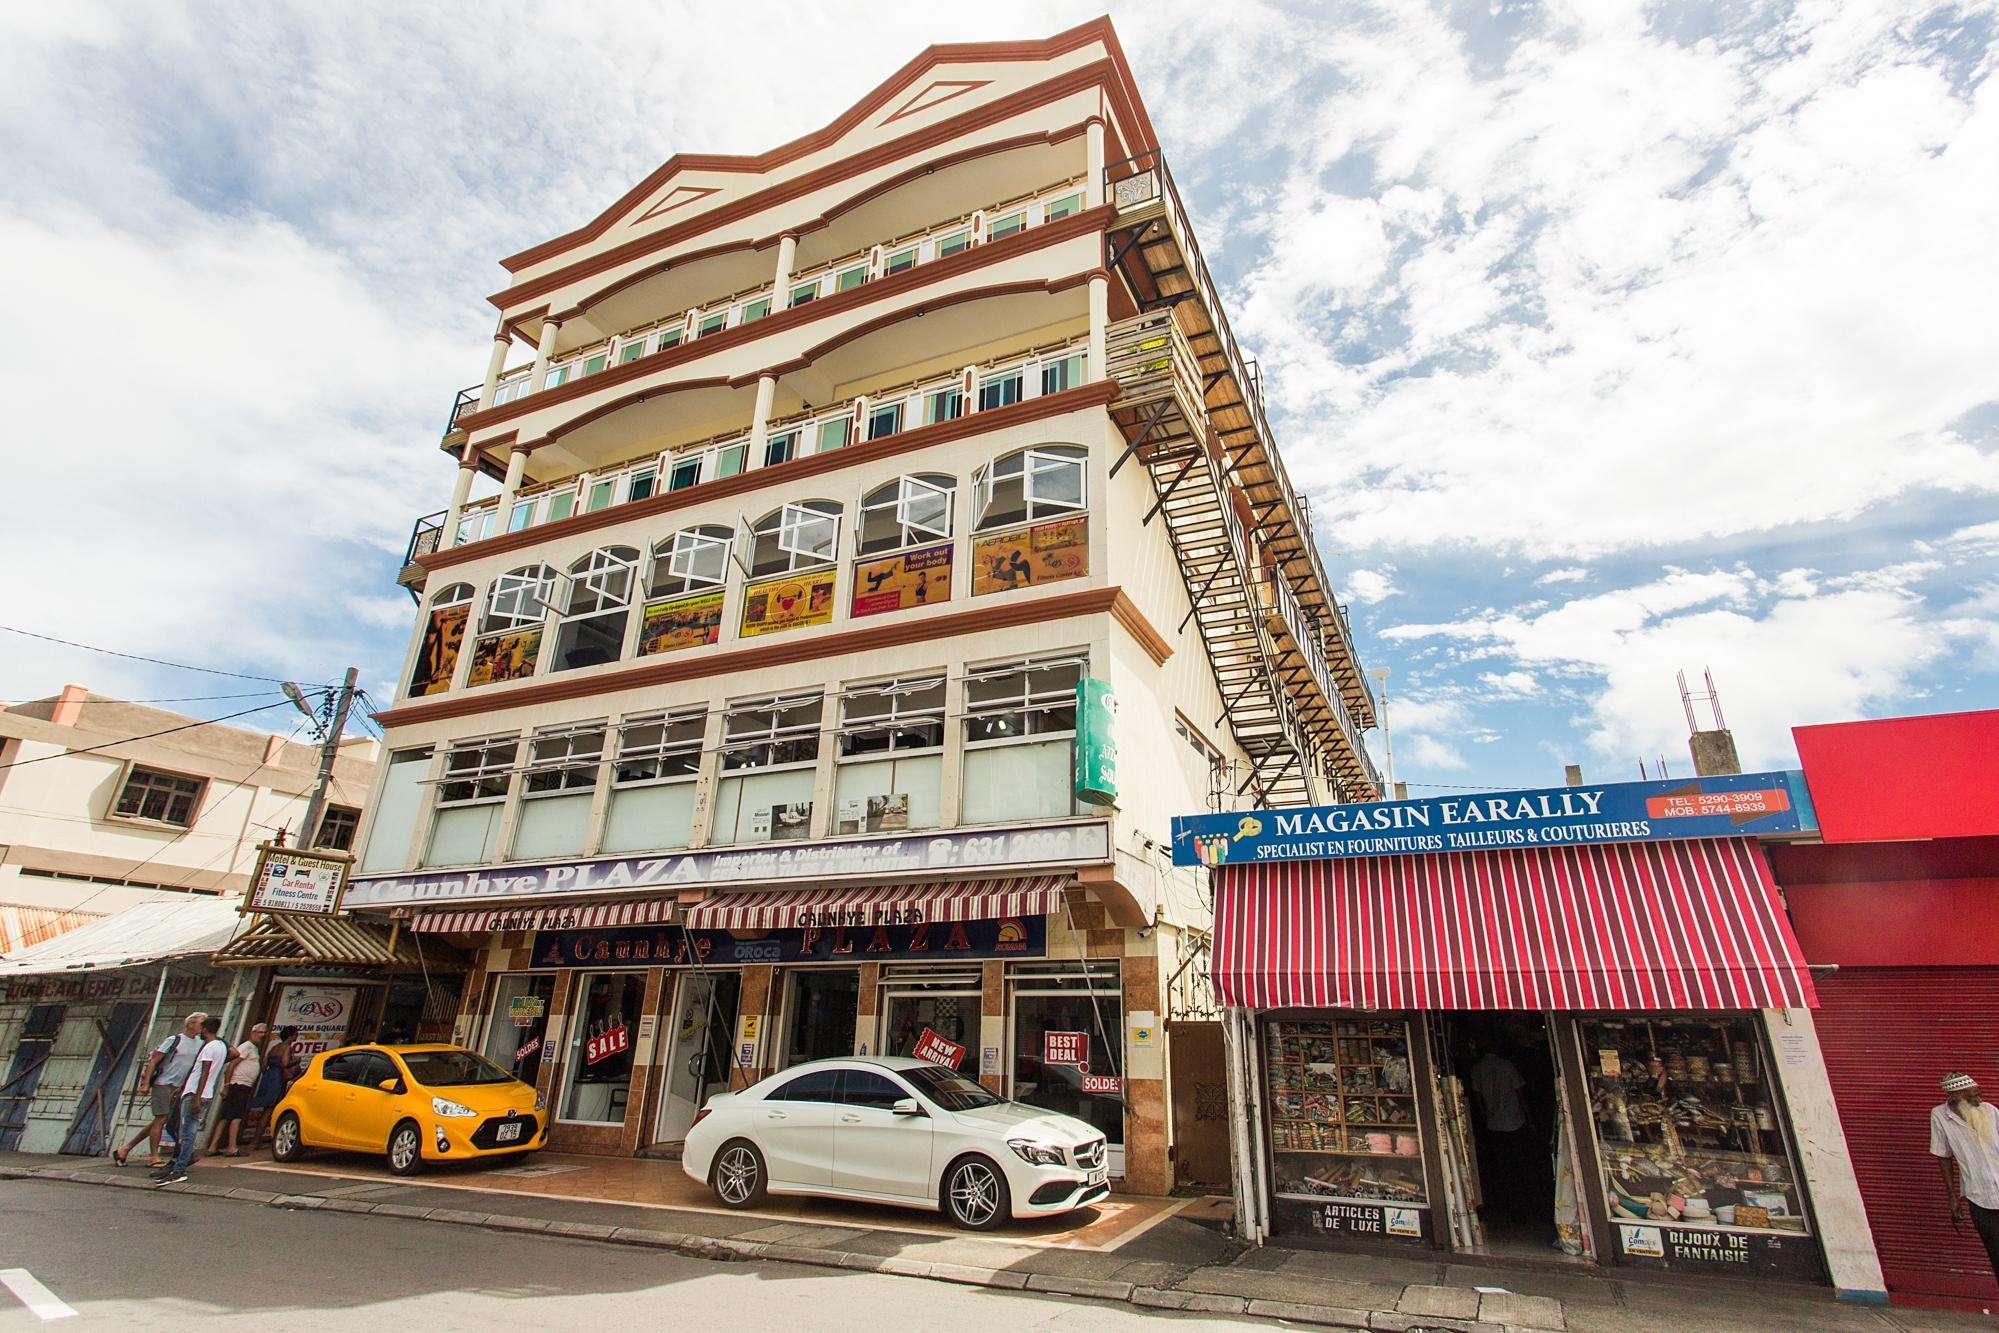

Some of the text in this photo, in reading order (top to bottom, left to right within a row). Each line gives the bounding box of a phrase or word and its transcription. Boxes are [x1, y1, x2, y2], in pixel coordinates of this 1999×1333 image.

[909, 547, 948, 561] Work out
[905, 556, 947, 572] your body
[1667, 792, 1763, 807] TEL: 5290-3909
[1274, 791, 1604, 836] MAGASIN EARALLY
[1664, 802, 1766, 817] MOB: 5744-8939
[1257, 820, 1650, 859] SPECIALIST EN FOURNITURES TAILLEURS & COUTURIERES
[780, 850, 792, 862] &
[881, 841, 902, 856] of
[962, 836, 1006, 864] 631
[290, 857, 297, 865] &
[297, 857, 320, 869] Guest
[320, 861, 342, 872] House
[540, 856, 703, 892] PLAZA
[282, 879, 316, 890] Car Rental
[272, 888, 319, 900] Fitness Centre
[541, 914, 576, 929] PLAZA
[875, 908, 923, 925] PLAZA
[800, 921, 971, 955] PLAZA
[516, 1038, 539, 1060] SOLDES
[588, 1030, 626, 1060] SALE
[931, 1036, 957, 1056] NEW
[1049, 1035, 1077, 1048] BEST
[920, 1045, 955, 1069] ARRIVAL
[1049, 1048, 1077, 1061] DEAL
[1324, 1205, 1380, 1220] ARTICLES
[1325, 1217, 1380, 1233] DE LUXE
[1669, 1231, 1748, 1249] BIJOUX DE
[1675, 1246, 1750, 1263] FANTAISIE
